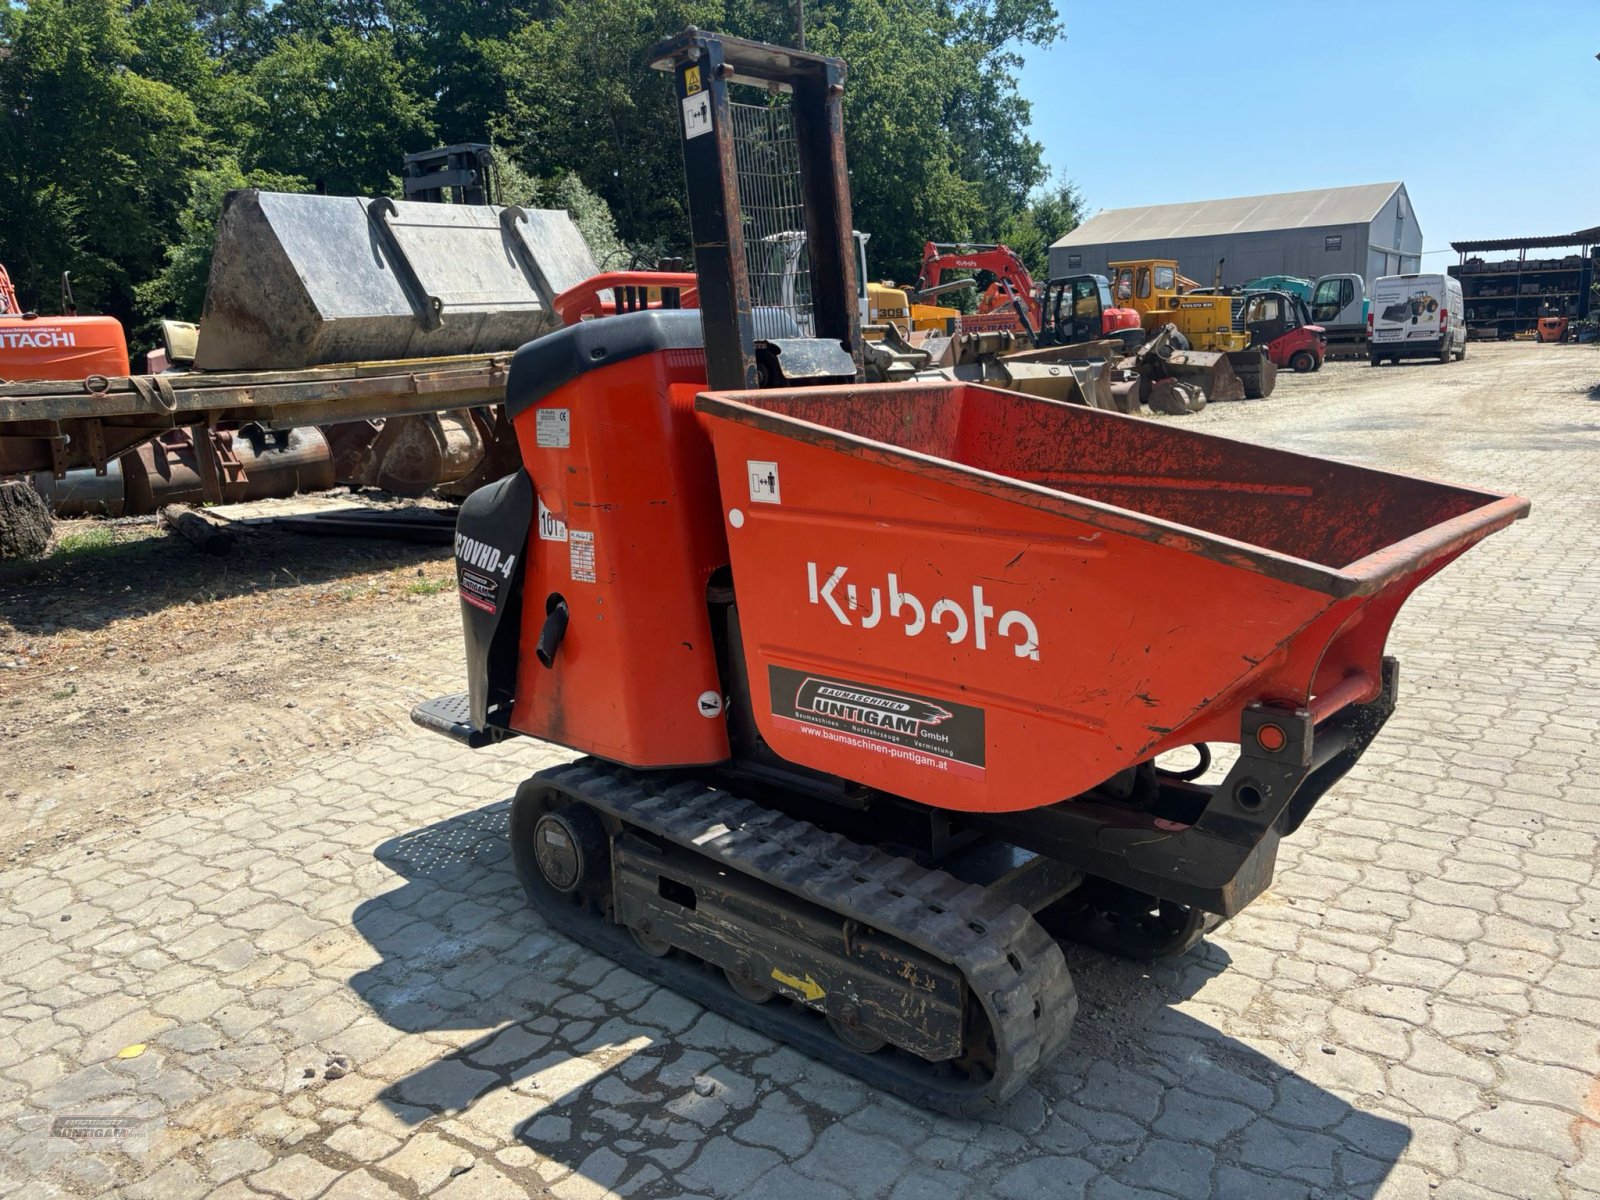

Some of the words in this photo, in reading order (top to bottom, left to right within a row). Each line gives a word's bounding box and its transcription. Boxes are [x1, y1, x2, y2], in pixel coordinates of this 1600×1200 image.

[879, 308, 903, 318] 309
[807, 561, 1040, 662] Kubota
[821, 687, 905, 710] BAUMASCHINEN
[795, 711, 840, 727] Baumaschinen
[852, 724, 900, 742] Nutzfahrzeuge
[913, 740, 954, 757] Vermietung
[800, 724, 948, 771] www.baumaschinen-puntigam.at
[920, 729, 949, 743] GmbH
